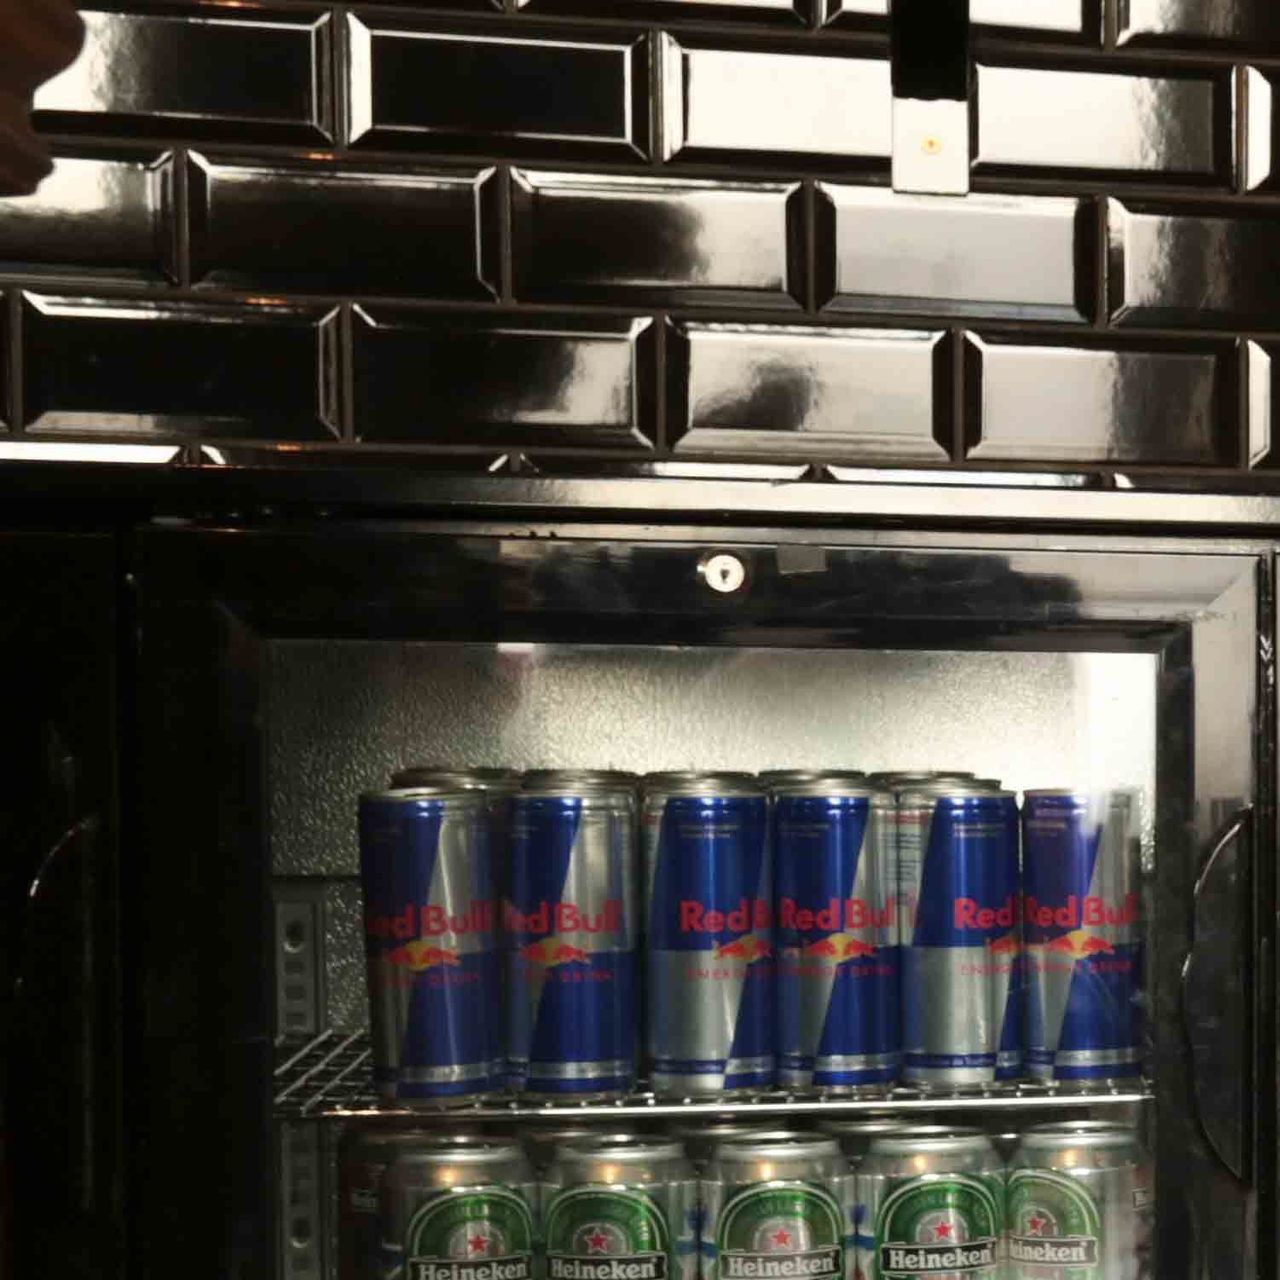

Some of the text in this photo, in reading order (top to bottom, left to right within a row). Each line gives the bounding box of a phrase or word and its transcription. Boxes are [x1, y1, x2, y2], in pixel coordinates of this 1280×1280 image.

[679, 899, 748, 933] Red
[953, 896, 1017, 930] Red
[551, 1259, 656, 1280] Heineken
[728, 1255, 835, 1277] Heineken
[889, 1242, 994, 1270] Heineken
